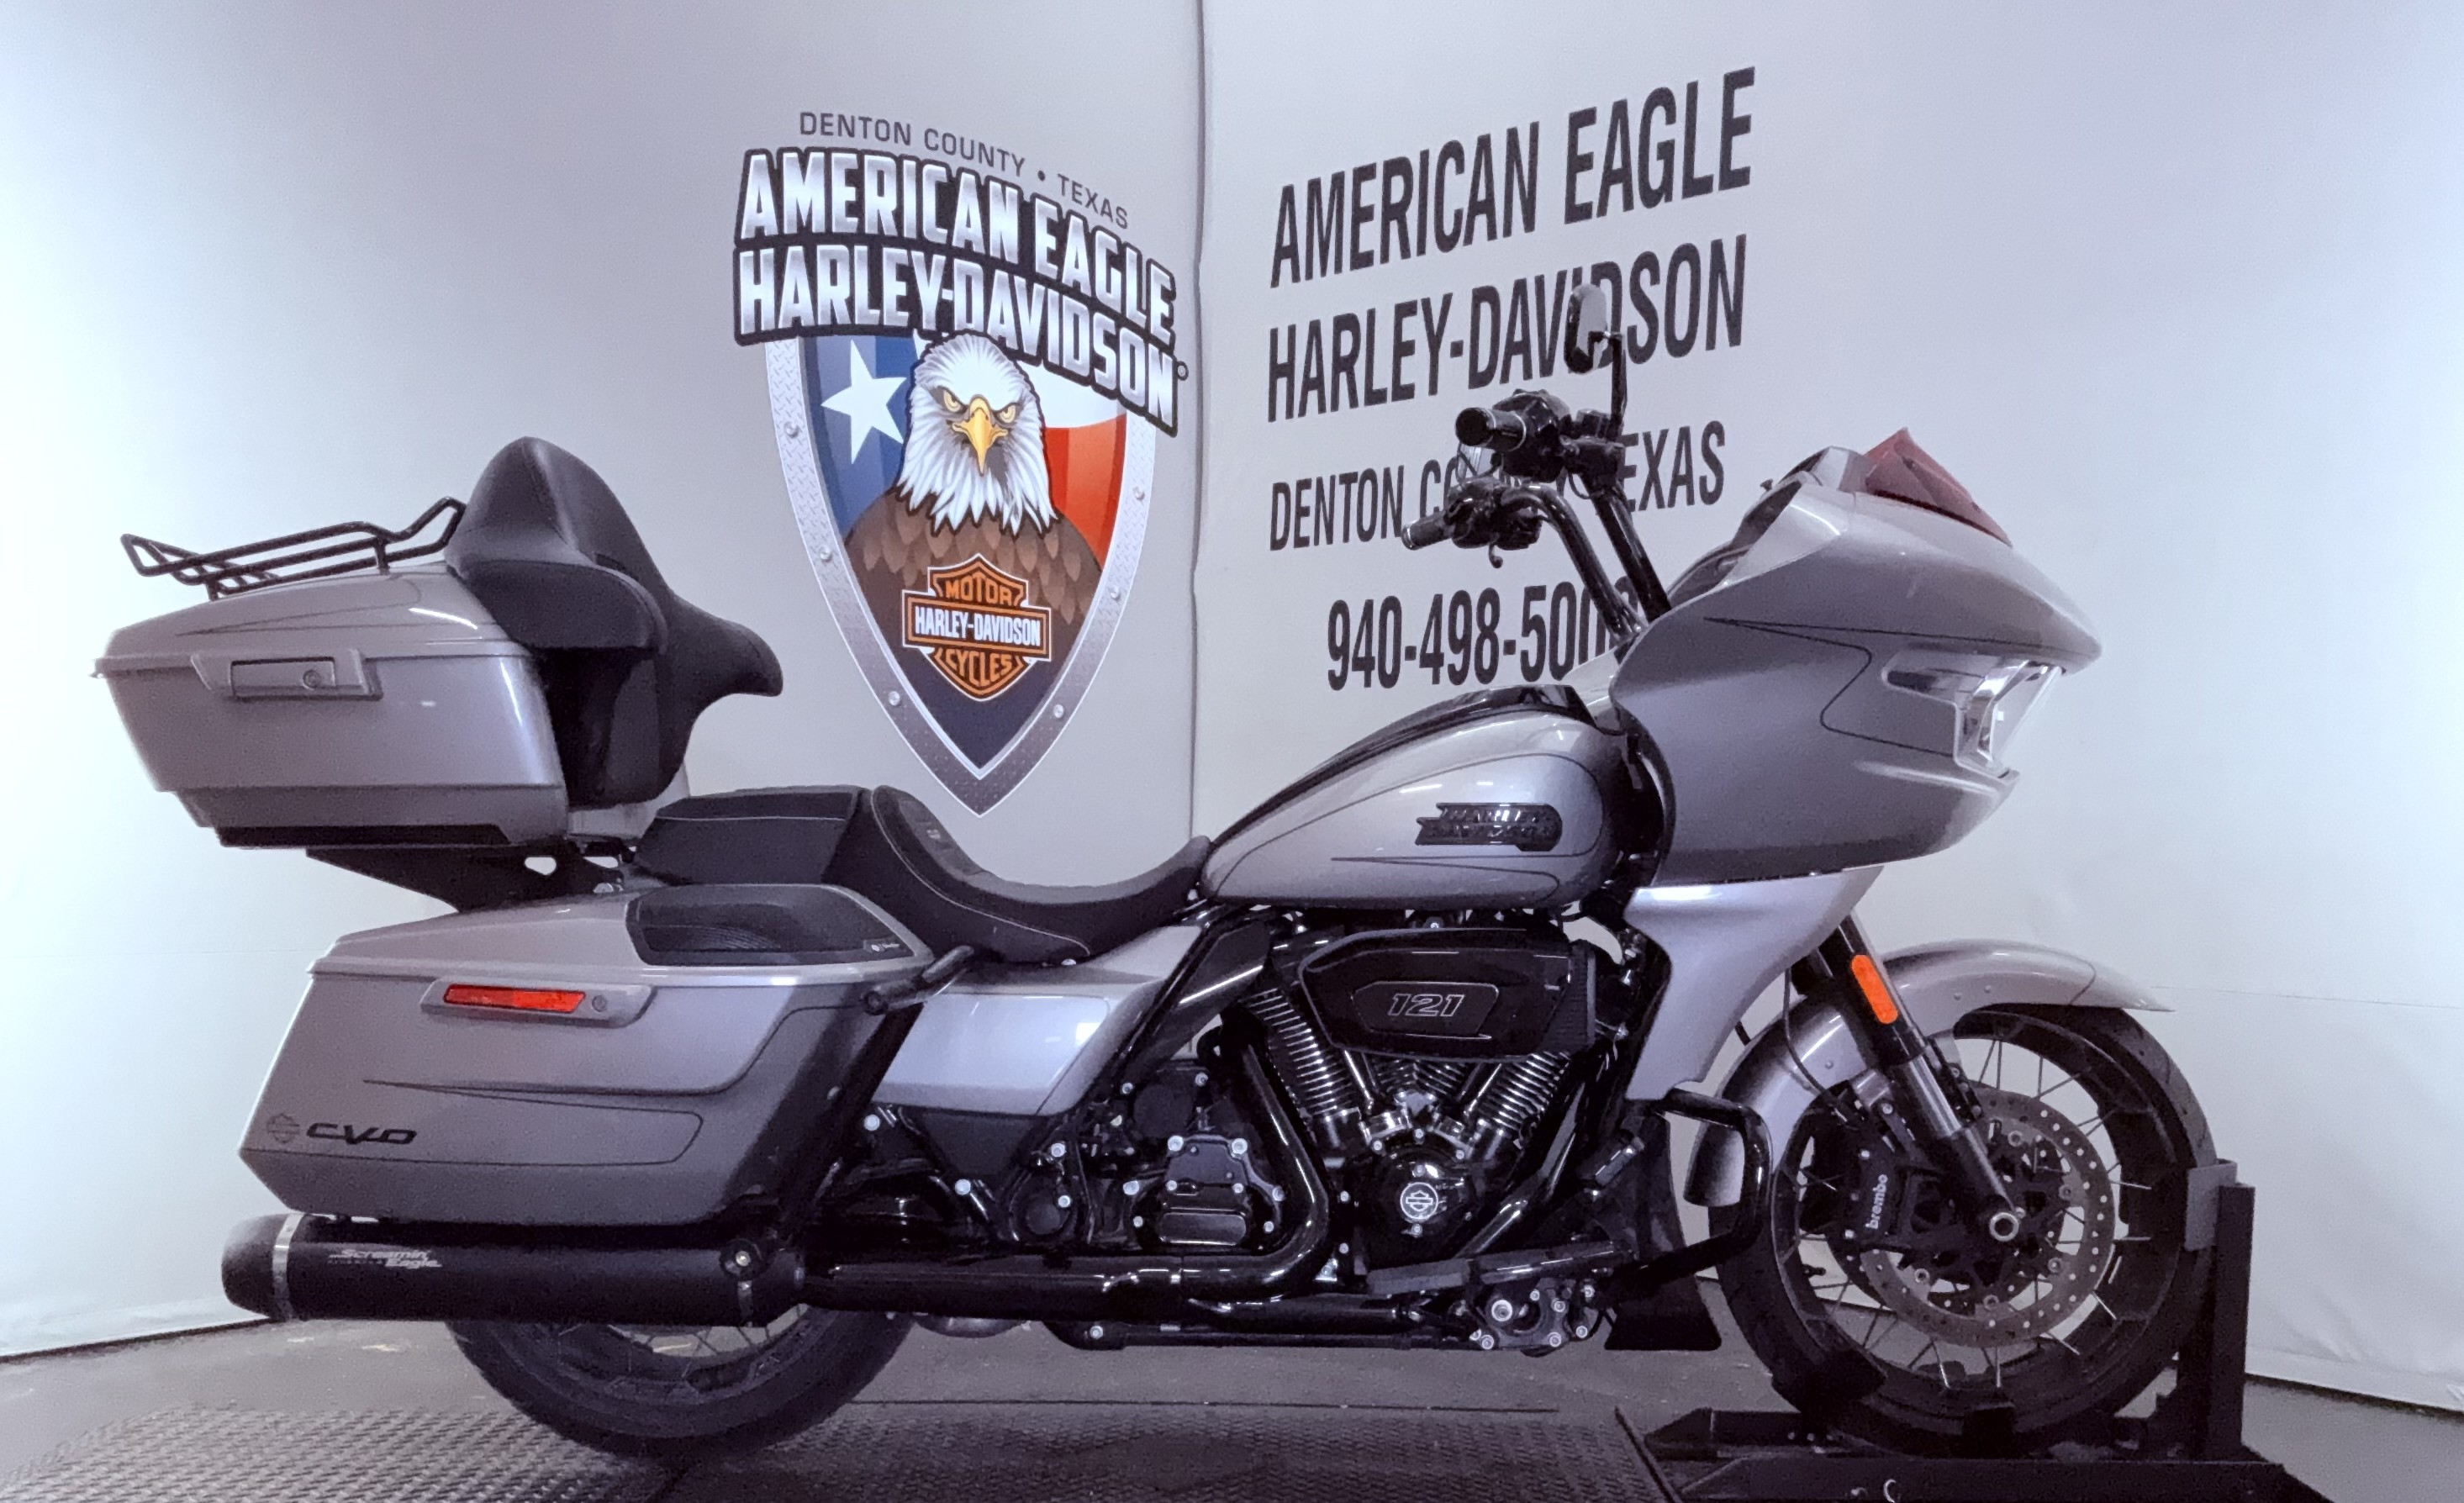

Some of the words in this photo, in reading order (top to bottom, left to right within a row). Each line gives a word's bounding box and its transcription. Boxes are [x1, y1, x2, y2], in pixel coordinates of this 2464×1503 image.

[799, 111, 911, 145] DENTON
[923, 128, 1026, 182] COUNTY
[1057, 172, 1128, 229] TEXAS
[1269, 120, 1541, 289] AMERICAN
[1564, 66, 1756, 225] EAGLE
[739, 150, 1021, 266] AMERICAN
[1033, 197, 1175, 339] EAGLE
[738, 243, 1176, 427] HARLEY-DAVIDSON
[1267, 233, 1747, 423] HARLEY-DAVDSON
[1269, 464, 1406, 551] DENTON
[1596, 419, 1726, 517] EXAS
[945, 570, 1012, 606] MOTOR
[914, 605, 1042, 647] HARLEY-DAVIDSON
[945, 648, 1013, 688] CYCLES
[1387, 993, 1465, 1017] 121
[306, 1122, 418, 1145] CVO
[1865, 1173, 1888, 1230] brembo
[384, 1258, 443, 1270] Eagle
